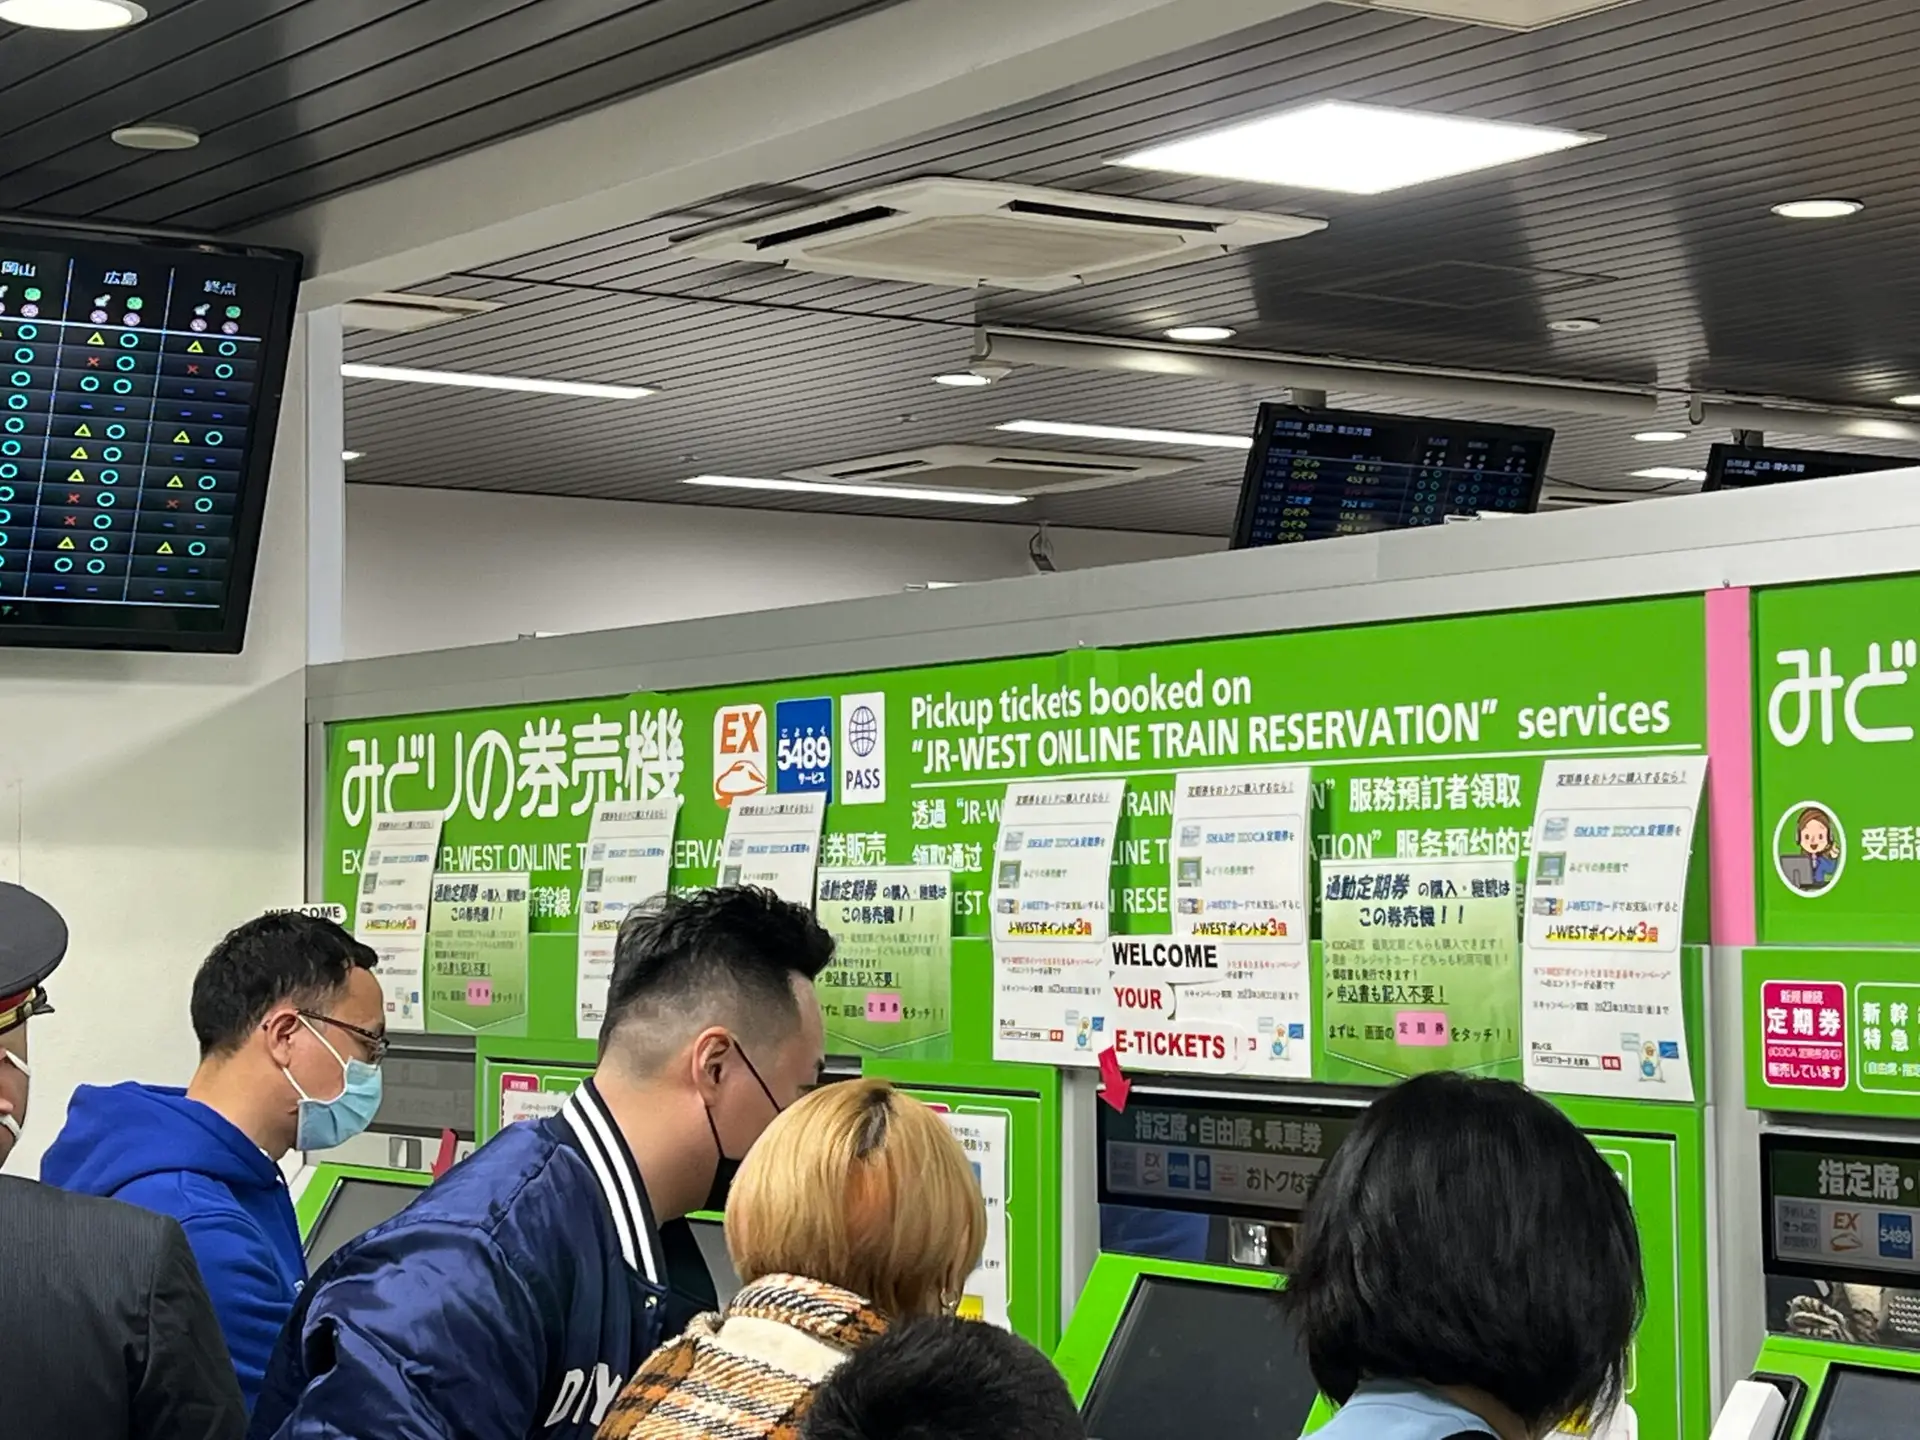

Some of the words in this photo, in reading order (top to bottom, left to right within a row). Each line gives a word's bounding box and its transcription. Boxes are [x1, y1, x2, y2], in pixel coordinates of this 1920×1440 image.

[103, 271, 138, 286] 広島
[911, 691, 993, 734] Pickup
[999, 683, 1082, 723] tickets
[1089, 668, 1204, 716] booked
[1212, 675, 1252, 707] on
[720, 711, 762, 754] EX
[1037, 724, 1141, 767] ONLINE
[1148, 716, 1239, 762] TRAIN
[1518, 691, 1671, 740] services
[341, 707, 686, 828] みどりの券売機
[777, 735, 831, 771] 5489
[845, 768, 881, 790] PASS
[1349, 773, 1521, 812] 服務預訂者領取
[911, 799, 946, 829] 透過
[508, 842, 572, 871] ONLINE
[1861, 826, 1920, 861] 受話
[1112, 941, 1218, 968] WELCOME
[1113, 986, 1163, 1010] YOUR
[1767, 1007, 1841, 1037] 定期券
[1863, 1002, 1920, 1027] 新幹
[1114, 1030, 1226, 1060] E-TICKETS
[1864, 1027, 1920, 1052] 特急
[1768, 1062, 1842, 1080] 販売しています
[1135, 1110, 1323, 1154] 指定席・自由席・乗車券
[1818, 1159, 1920, 1201] 指定席・
[1833, 1211, 1860, 1230] EX
